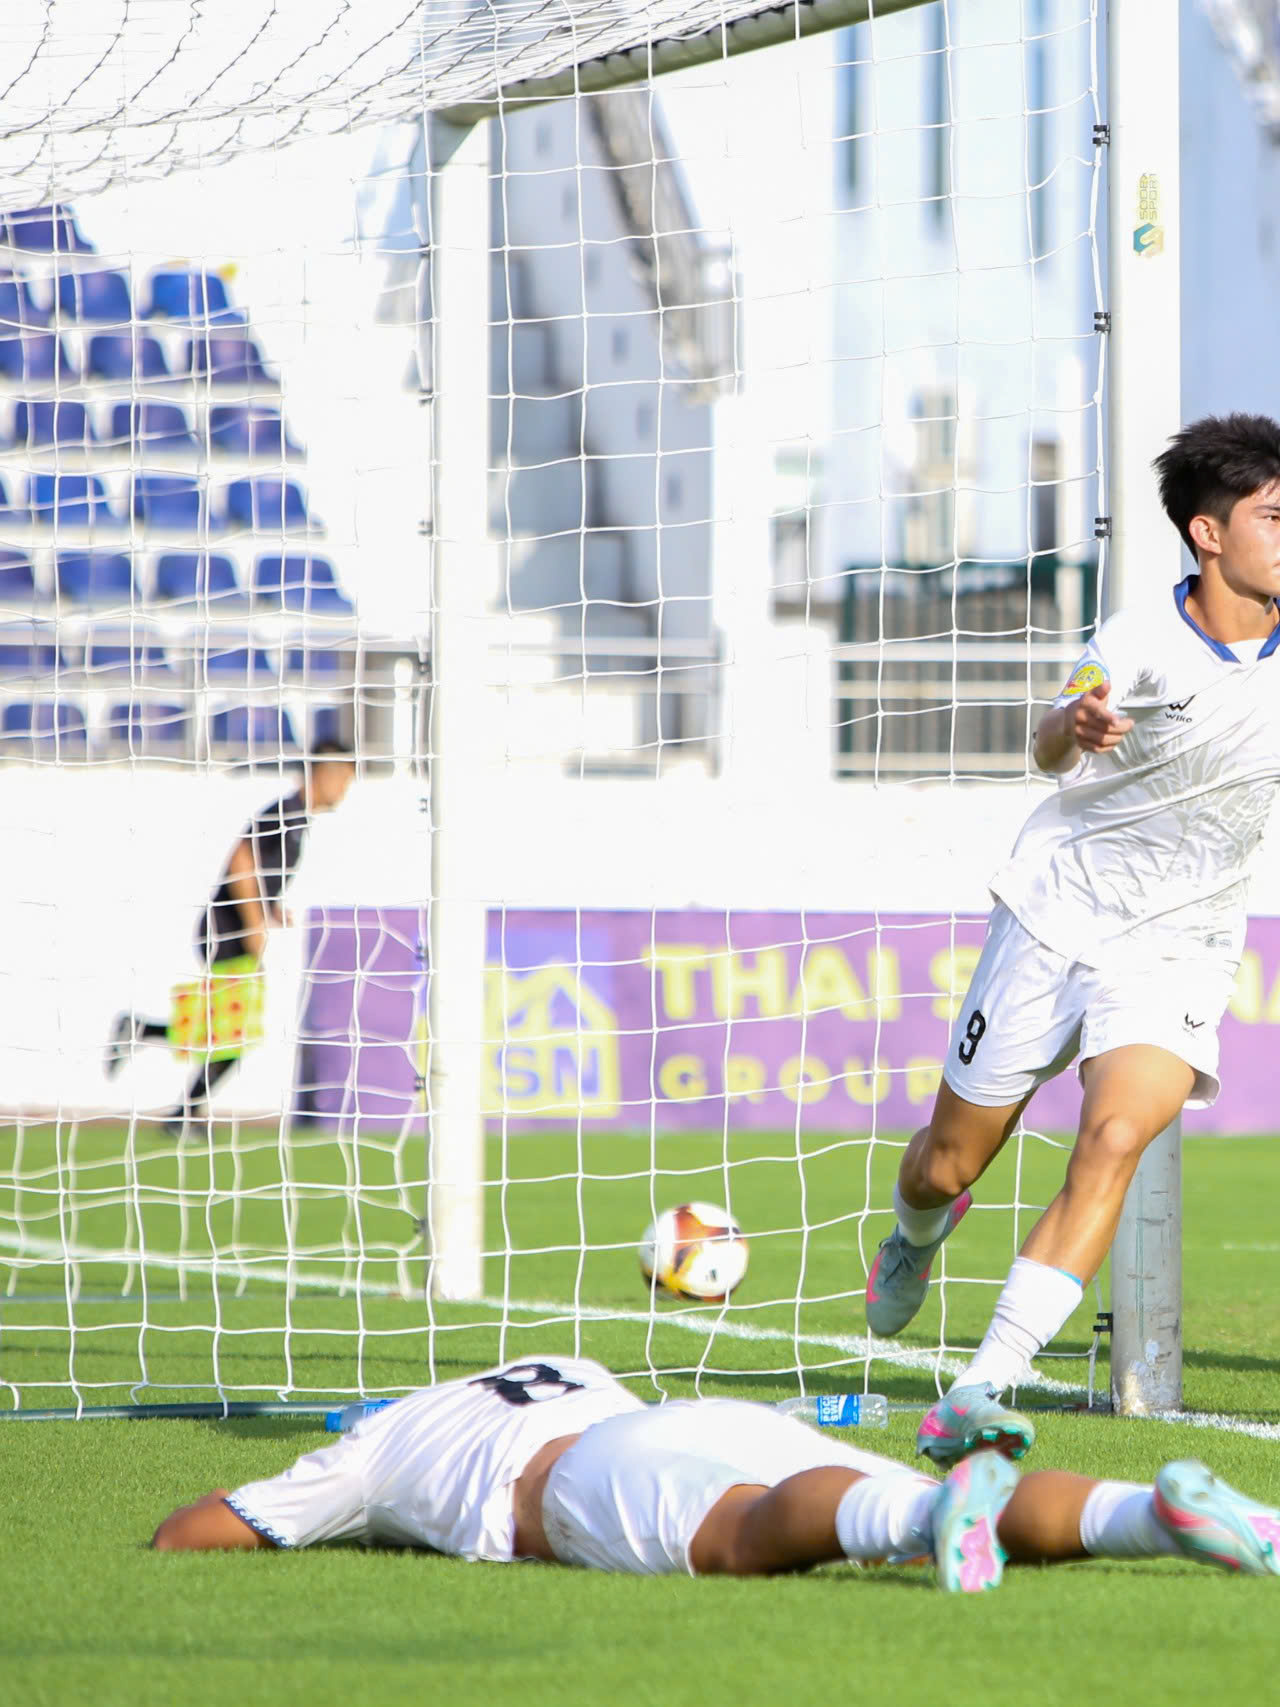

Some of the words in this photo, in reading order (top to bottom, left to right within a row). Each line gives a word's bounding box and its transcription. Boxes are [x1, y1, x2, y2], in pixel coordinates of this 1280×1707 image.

[642, 943, 903, 1023] THAI
[958, 1009, 987, 1066] 9
[658, 1053, 946, 1105] GROUP
